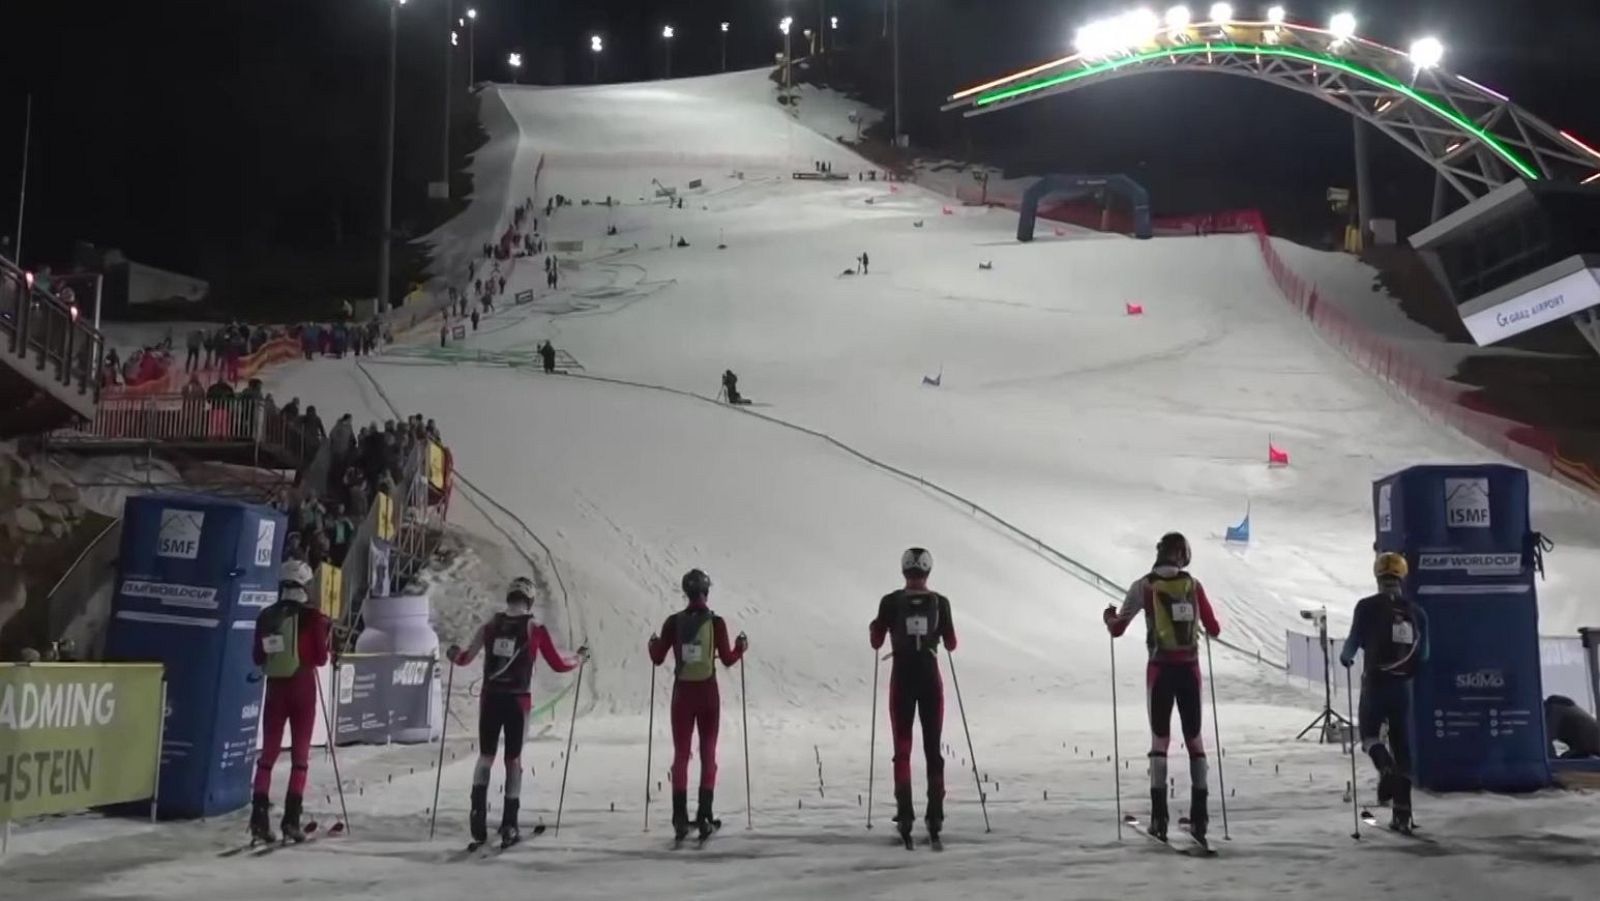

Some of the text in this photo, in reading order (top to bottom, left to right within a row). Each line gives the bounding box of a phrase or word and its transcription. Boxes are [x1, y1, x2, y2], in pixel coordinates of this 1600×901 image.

[1531, 294, 1565, 315] AIRPORT
[1450, 507, 1489, 524] ISMF
[157, 537, 197, 555] ISMF
[1422, 555, 1518, 567] ISMF WORLD CUP
[0, 682, 116, 730] ADMING
